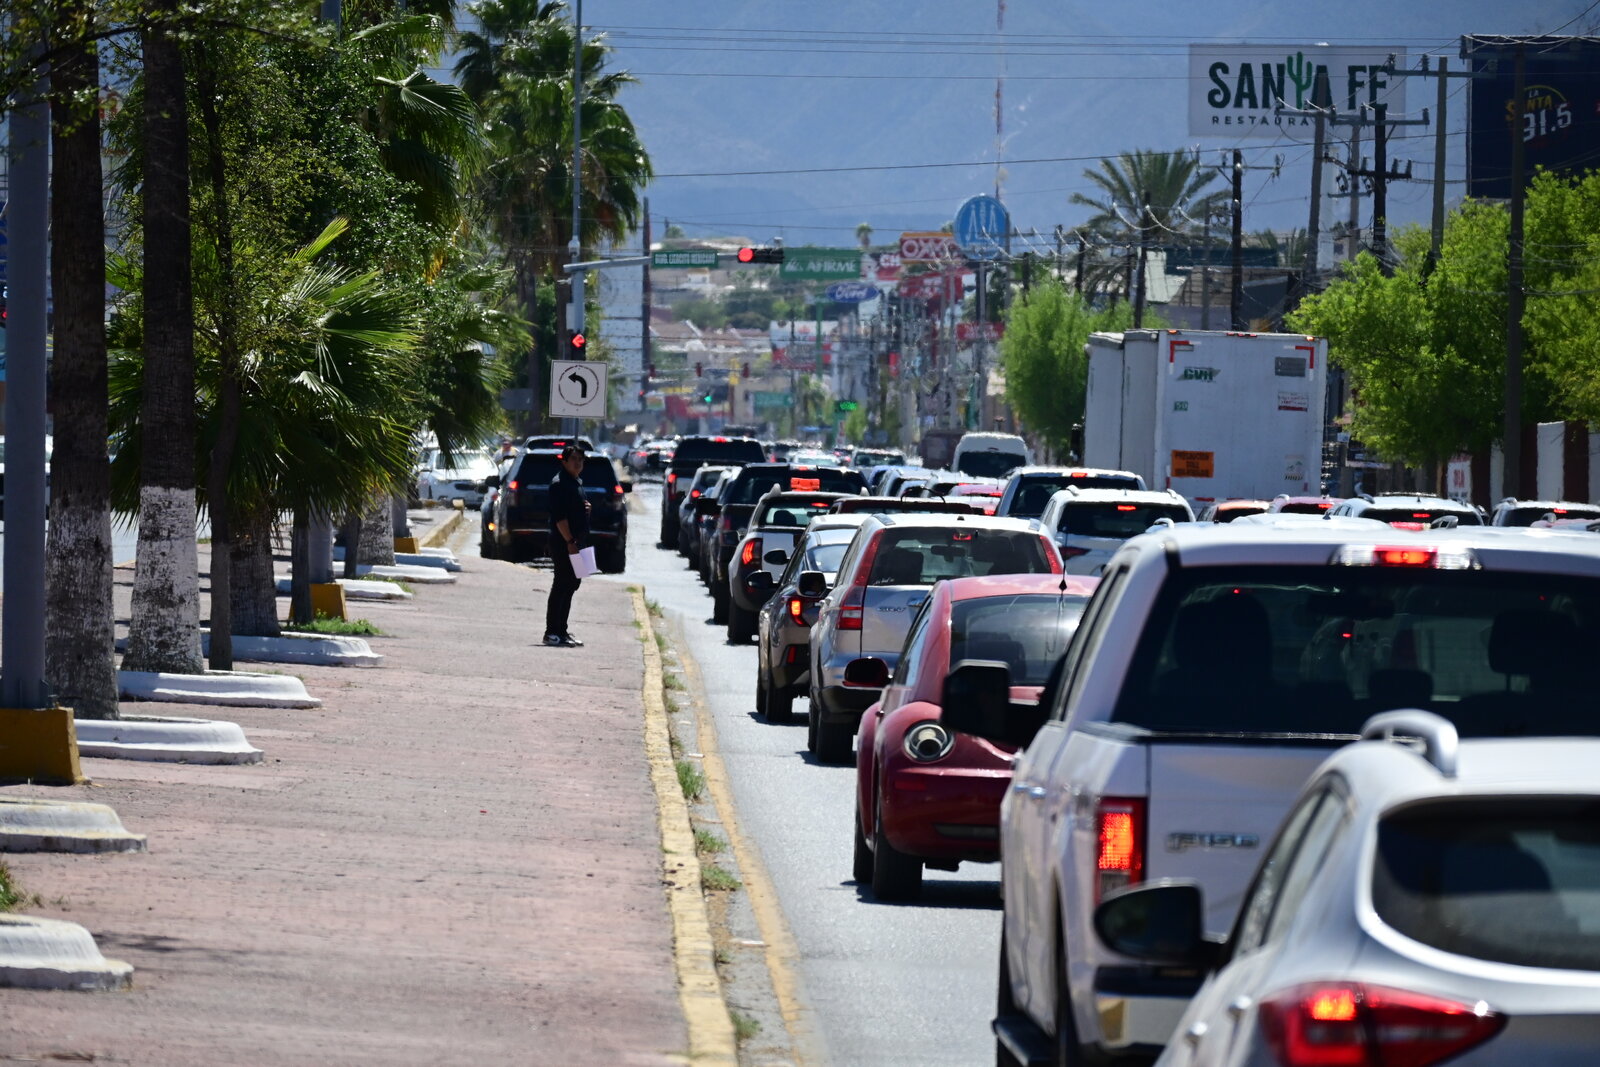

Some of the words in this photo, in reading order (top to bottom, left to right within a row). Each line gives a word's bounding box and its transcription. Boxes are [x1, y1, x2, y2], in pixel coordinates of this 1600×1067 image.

[1207, 51, 1333, 110] SANTA
[1347, 64, 1389, 110] FE
[1505, 95, 1553, 121] SNTA
[835, 285, 868, 299] Ford
